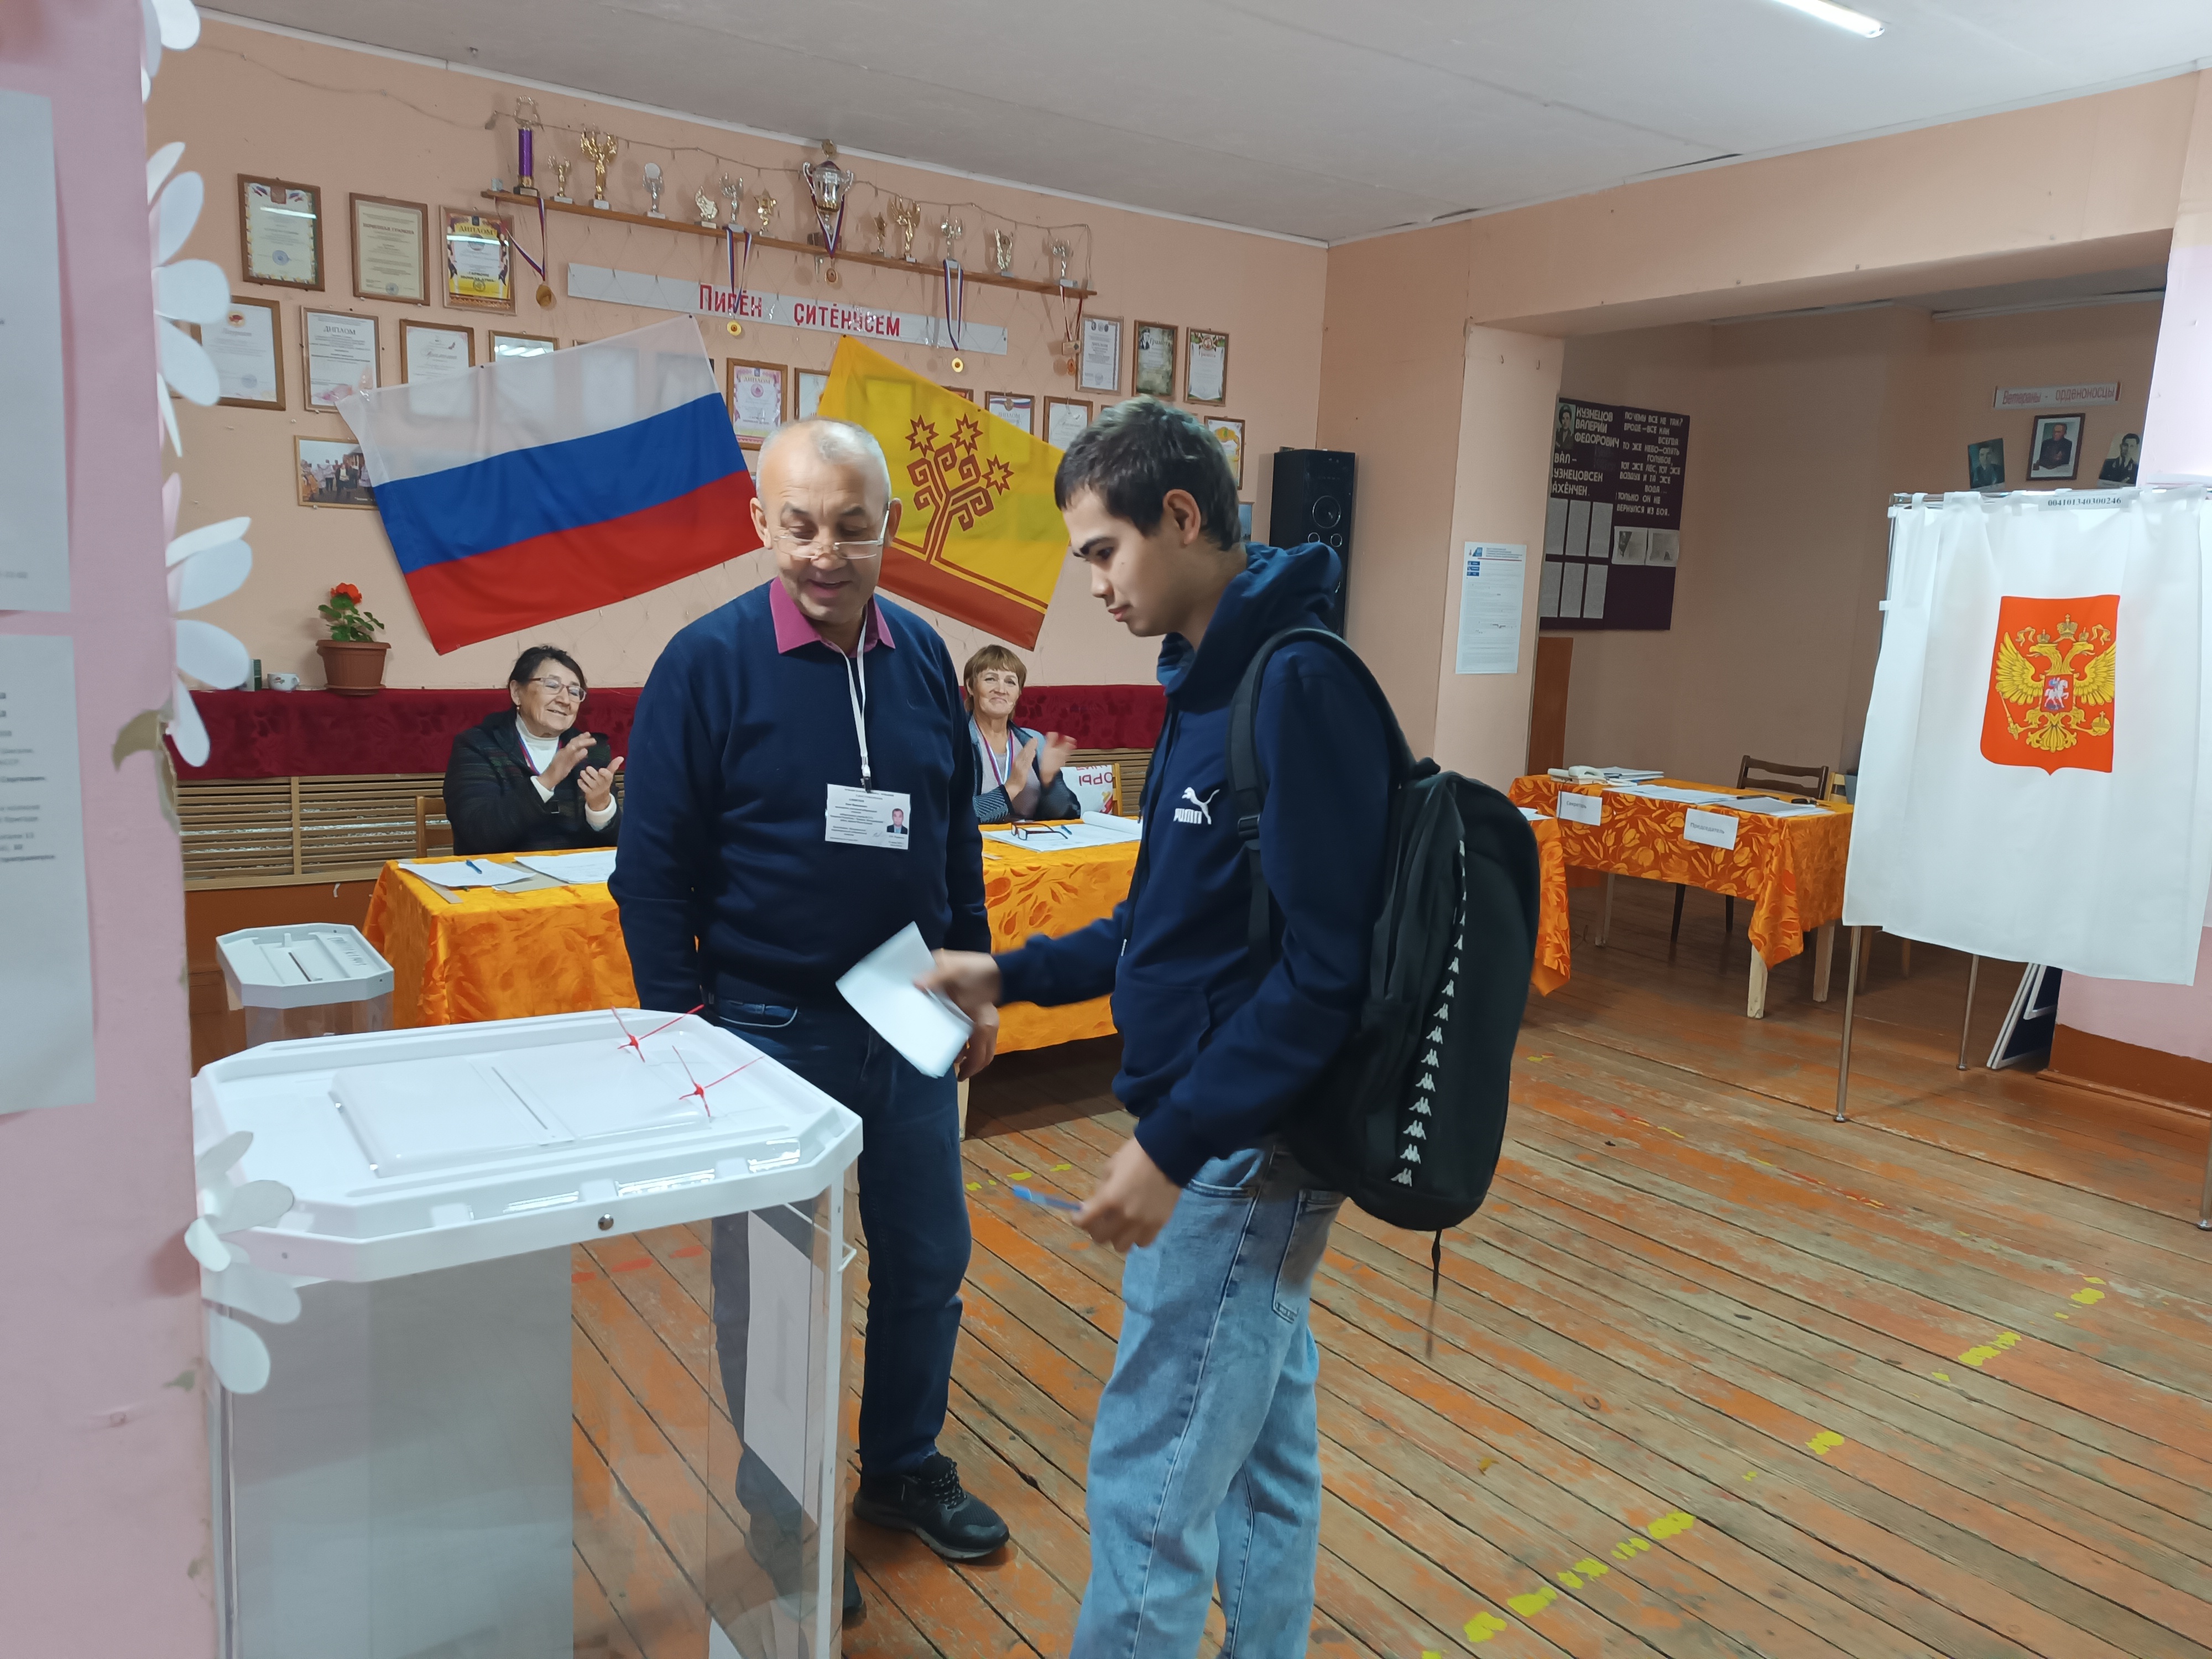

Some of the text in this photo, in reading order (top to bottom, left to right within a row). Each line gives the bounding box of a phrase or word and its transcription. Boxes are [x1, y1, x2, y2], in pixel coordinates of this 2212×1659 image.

[459, 225, 494, 236] ДИПЛОМ
[324, 326, 356, 335] ДИПЛОМ
[2056, 387, 2115, 403] орденоносцы
[1576, 406, 1613, 422] КУЗНЕЦОВ
[1625, 411, 1646, 422] ПОЧЕМУ
[1660, 417, 1667, 425] НЕ
[1670, 418, 1683, 427] ТАК?
[1659, 427, 1670, 436] КАК
[1574, 432, 1620, 448] ФЕДОРОВИЧ
[1623, 441, 1630, 450] ТО
[1632, 443, 1642, 451] ЖЕ
[1621, 461, 1630, 469] ТОТ
[1632, 462, 1643, 471] ЖЕ
[1646, 464, 1657, 474] ЛЕС,
[1659, 466, 1667, 474] ТОТ
[1620, 471, 1640, 481] ВОЗДУХ
[1660, 476, 1671, 484] ЖЕ
[1618, 492, 1639, 502] ТОЛЬКО
[1653, 496, 1661, 504] НЕ
[1616, 504, 1670, 516] ВЕРНУЛСЯ ИЗ БОЯ.
[1566, 800, 1587, 808] Секретарь
[1173, 808, 1202, 825] PUMA
[1690, 822, 1725, 834] Председатель
